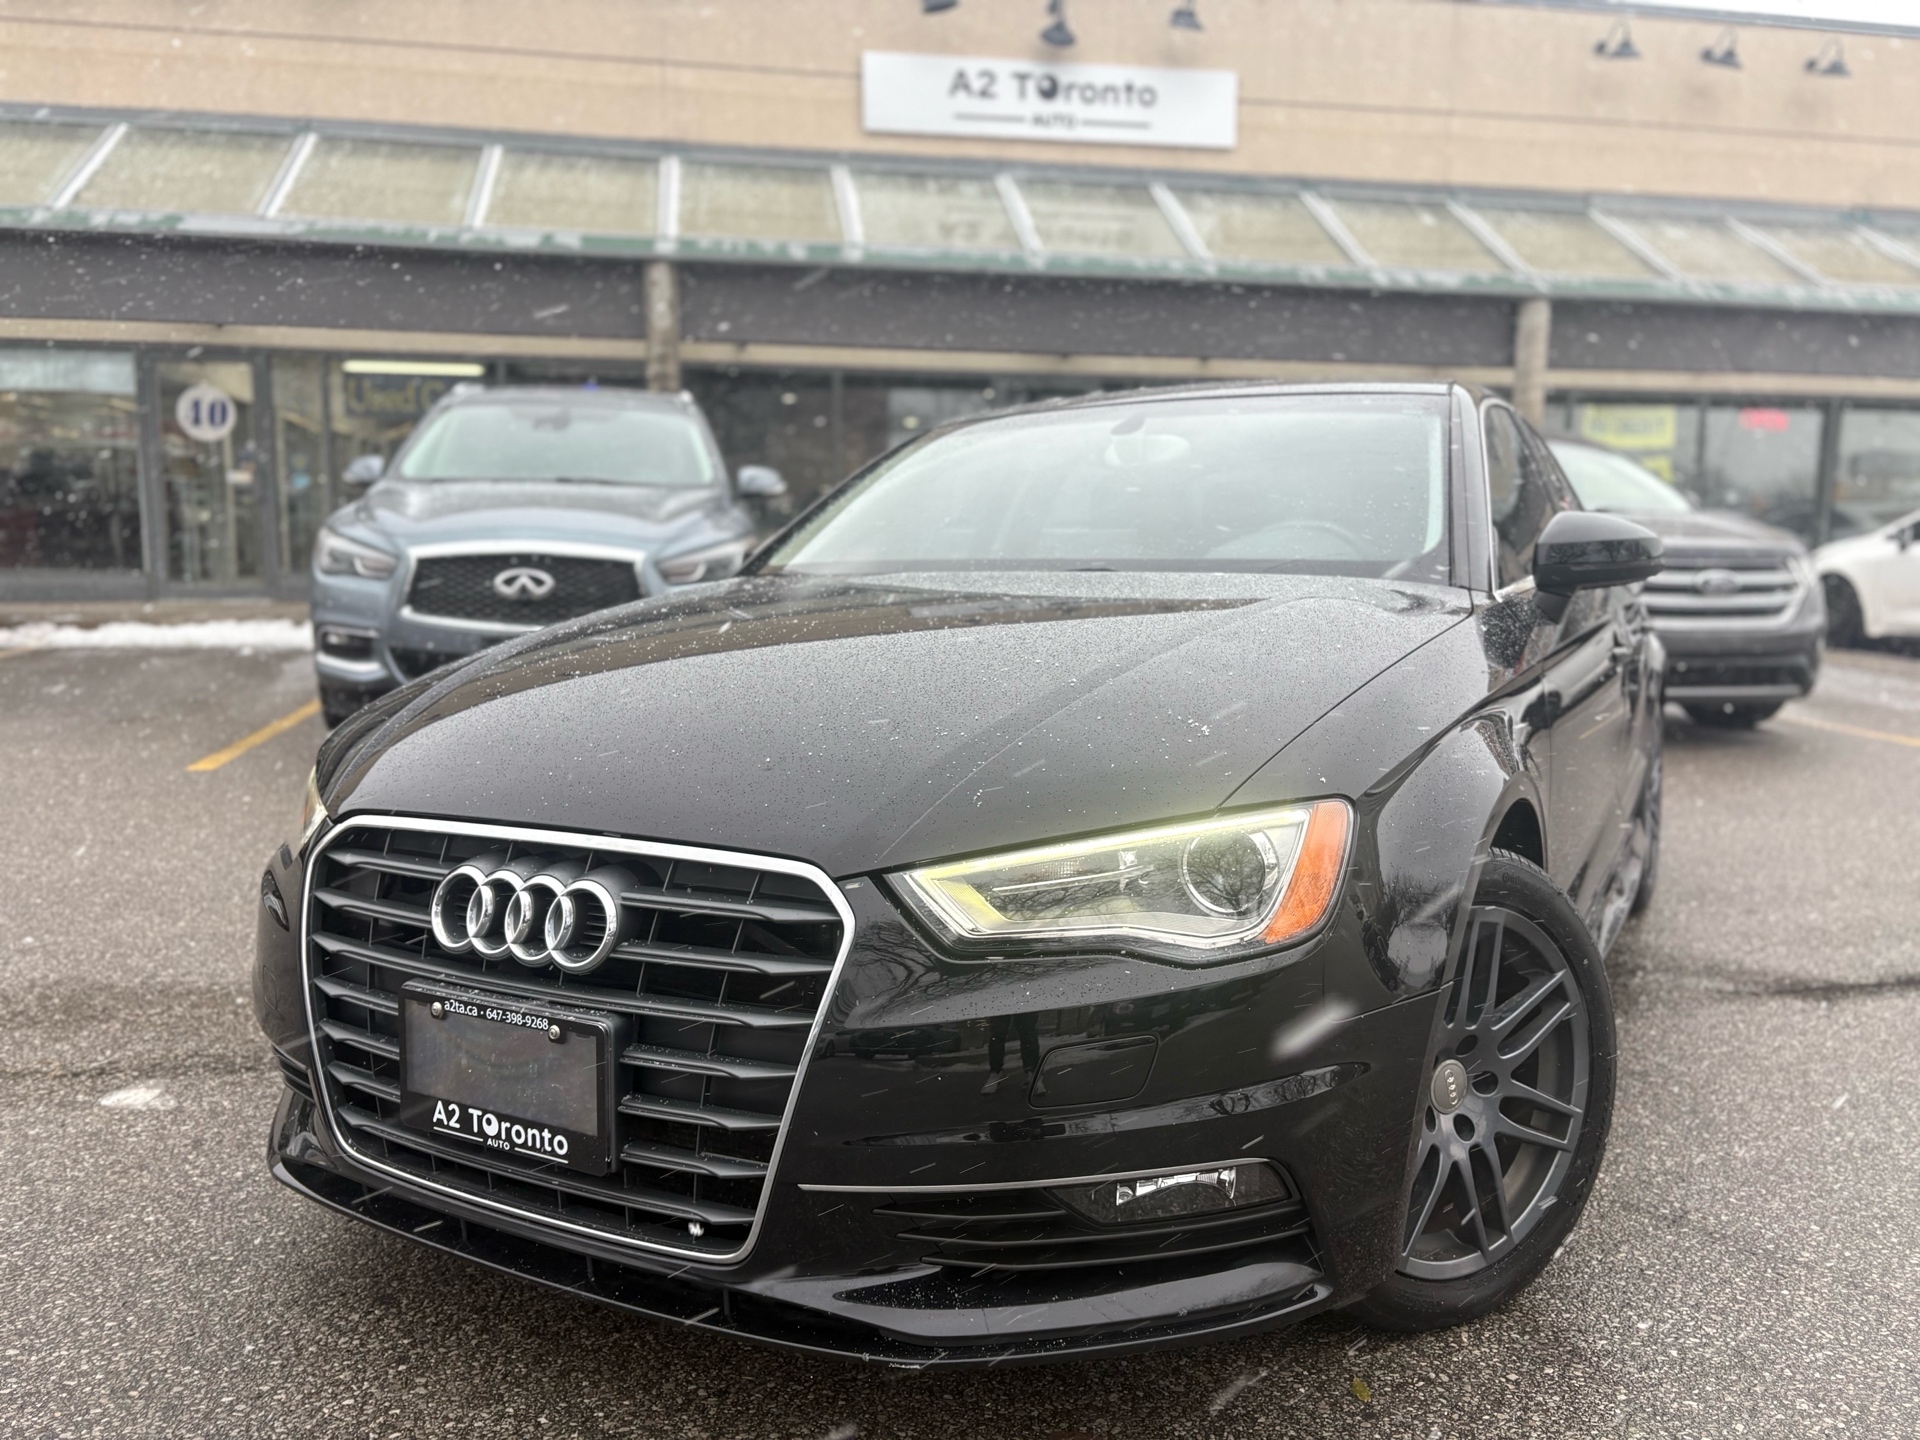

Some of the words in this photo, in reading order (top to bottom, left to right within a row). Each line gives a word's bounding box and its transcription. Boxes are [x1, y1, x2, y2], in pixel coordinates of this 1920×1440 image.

[950, 69, 997, 98] A2
[191, 398, 228, 428] 10
[444, 999, 478, 1017] a2ta.ca
[485, 1008, 549, 1030] 647-398-9268
[432, 1100, 460, 1129] A2
[486, 1139, 511, 1151] AUTO
